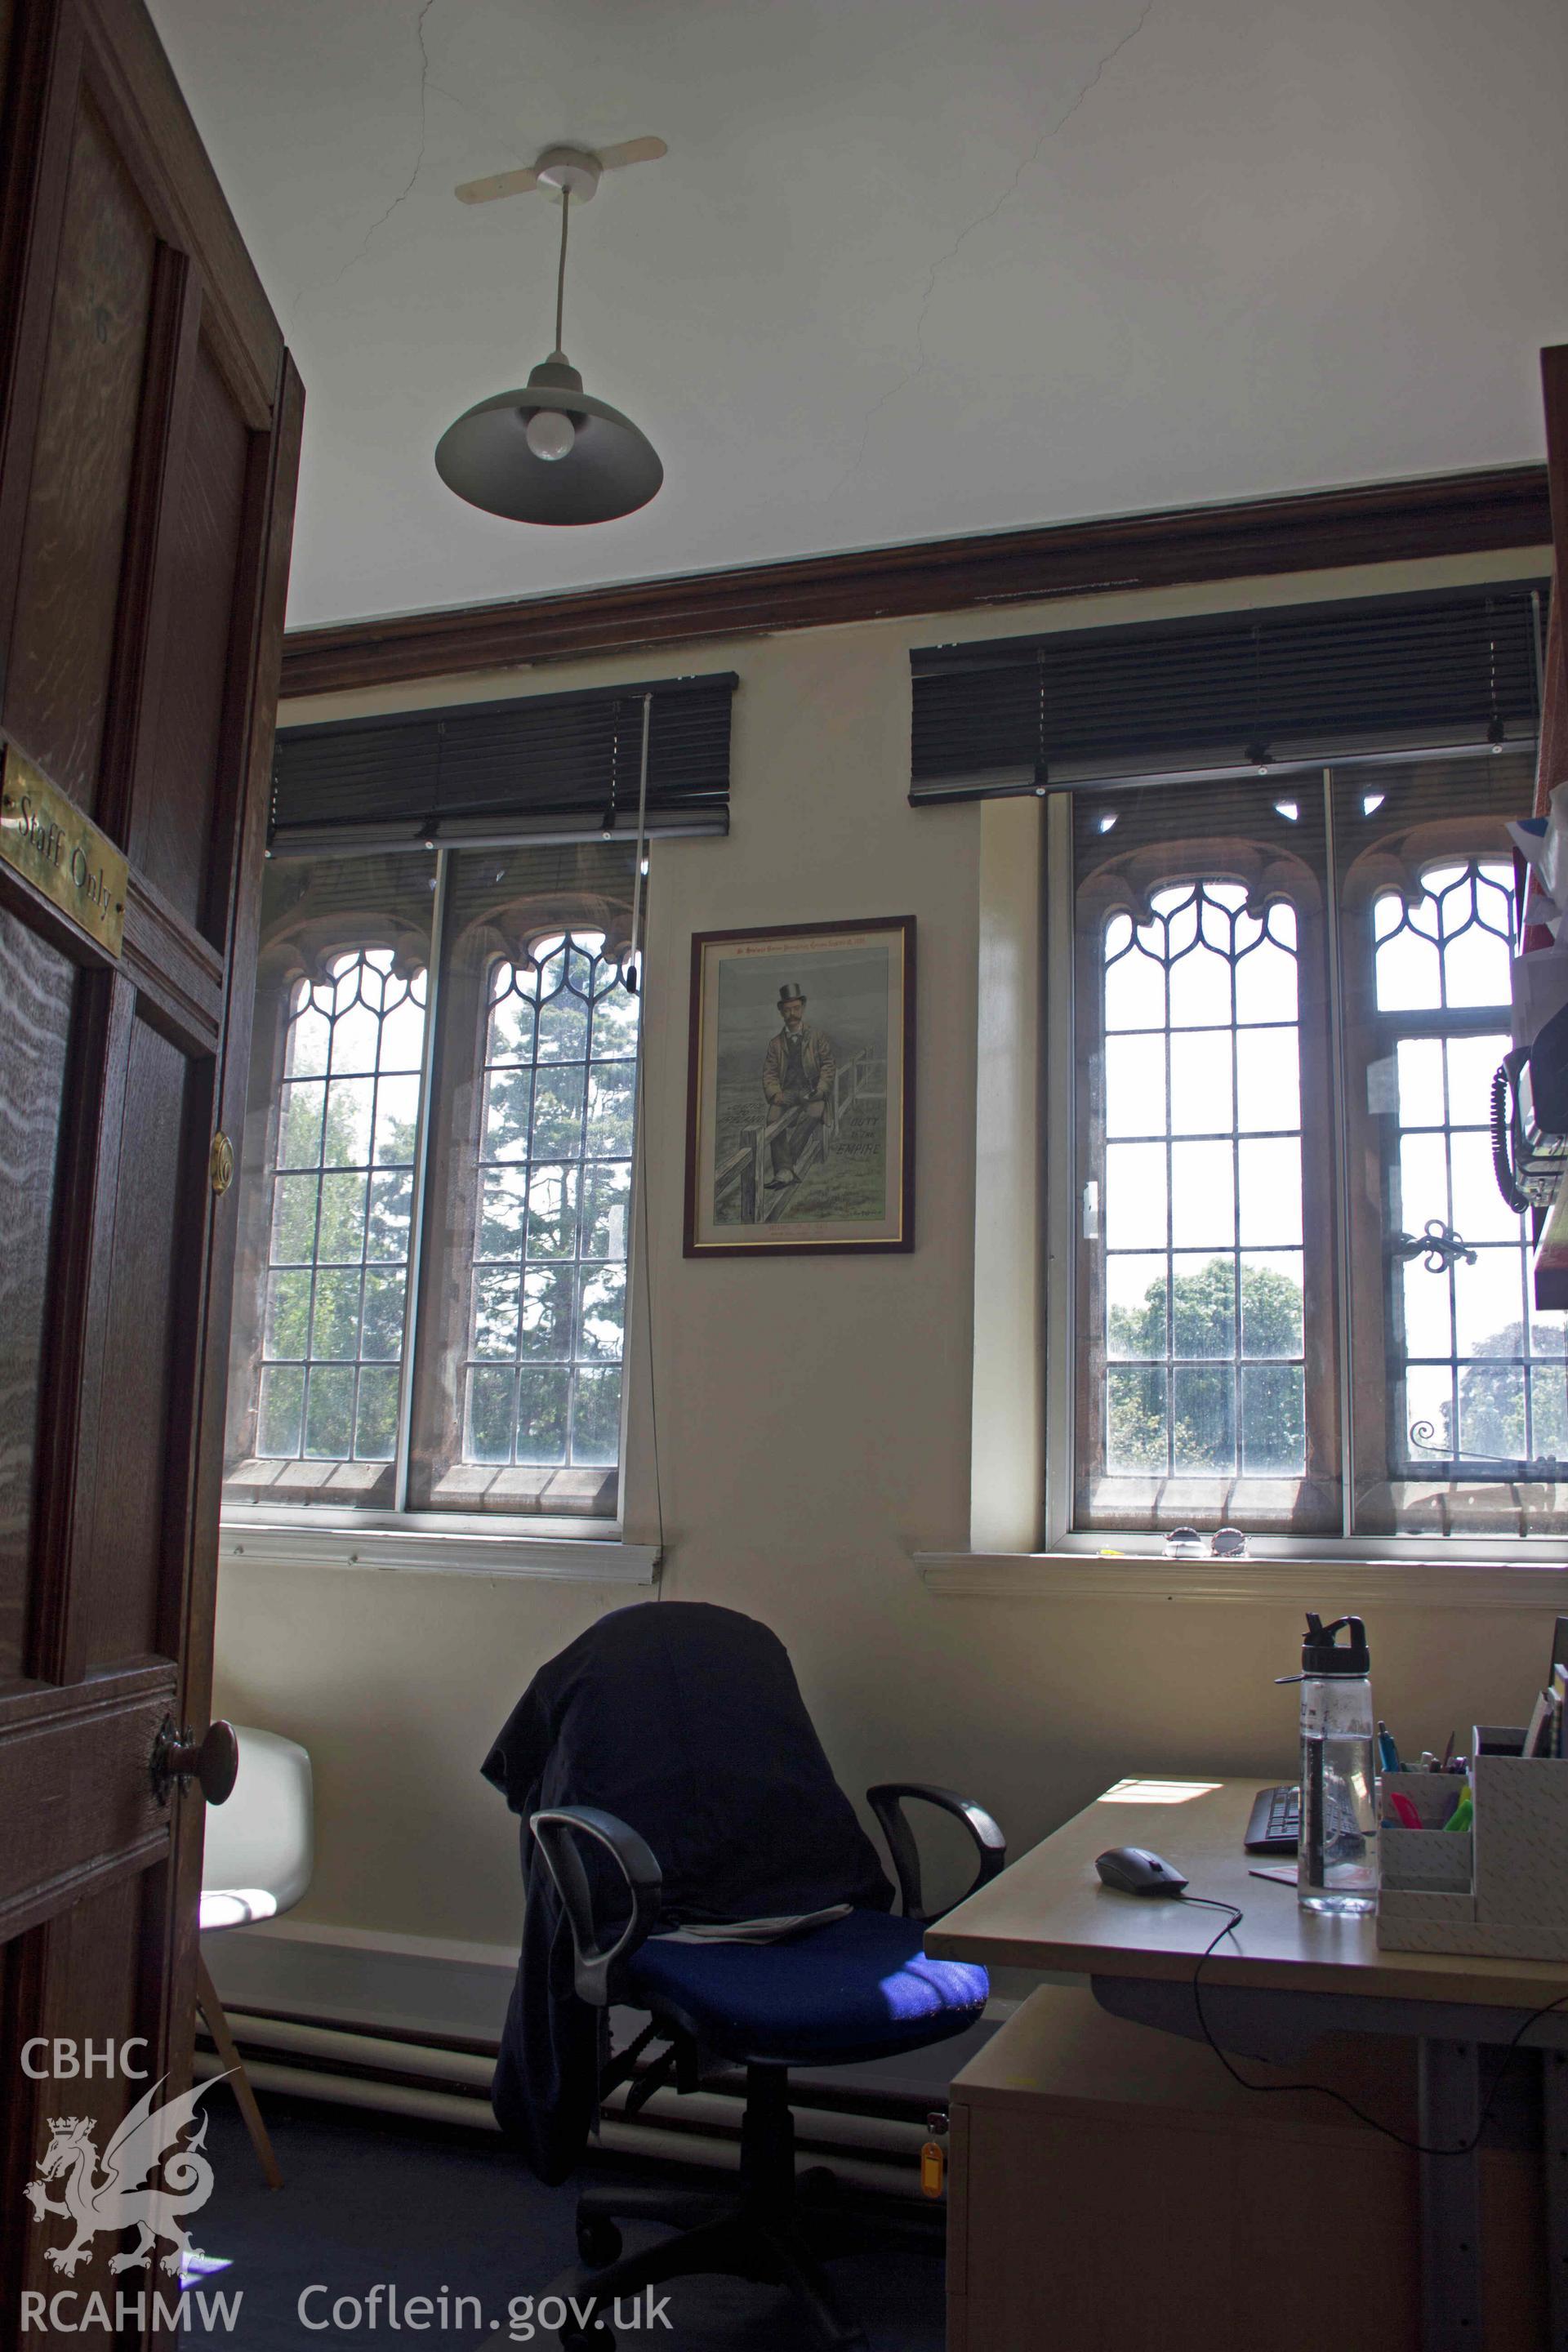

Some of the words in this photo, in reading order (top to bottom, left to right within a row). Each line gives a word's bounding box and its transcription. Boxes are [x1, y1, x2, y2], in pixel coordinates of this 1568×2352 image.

[19, 795, 65, 866] Staff
[71, 846, 112, 920] Only
[836, 1143, 881, 1156] EMPIRE
